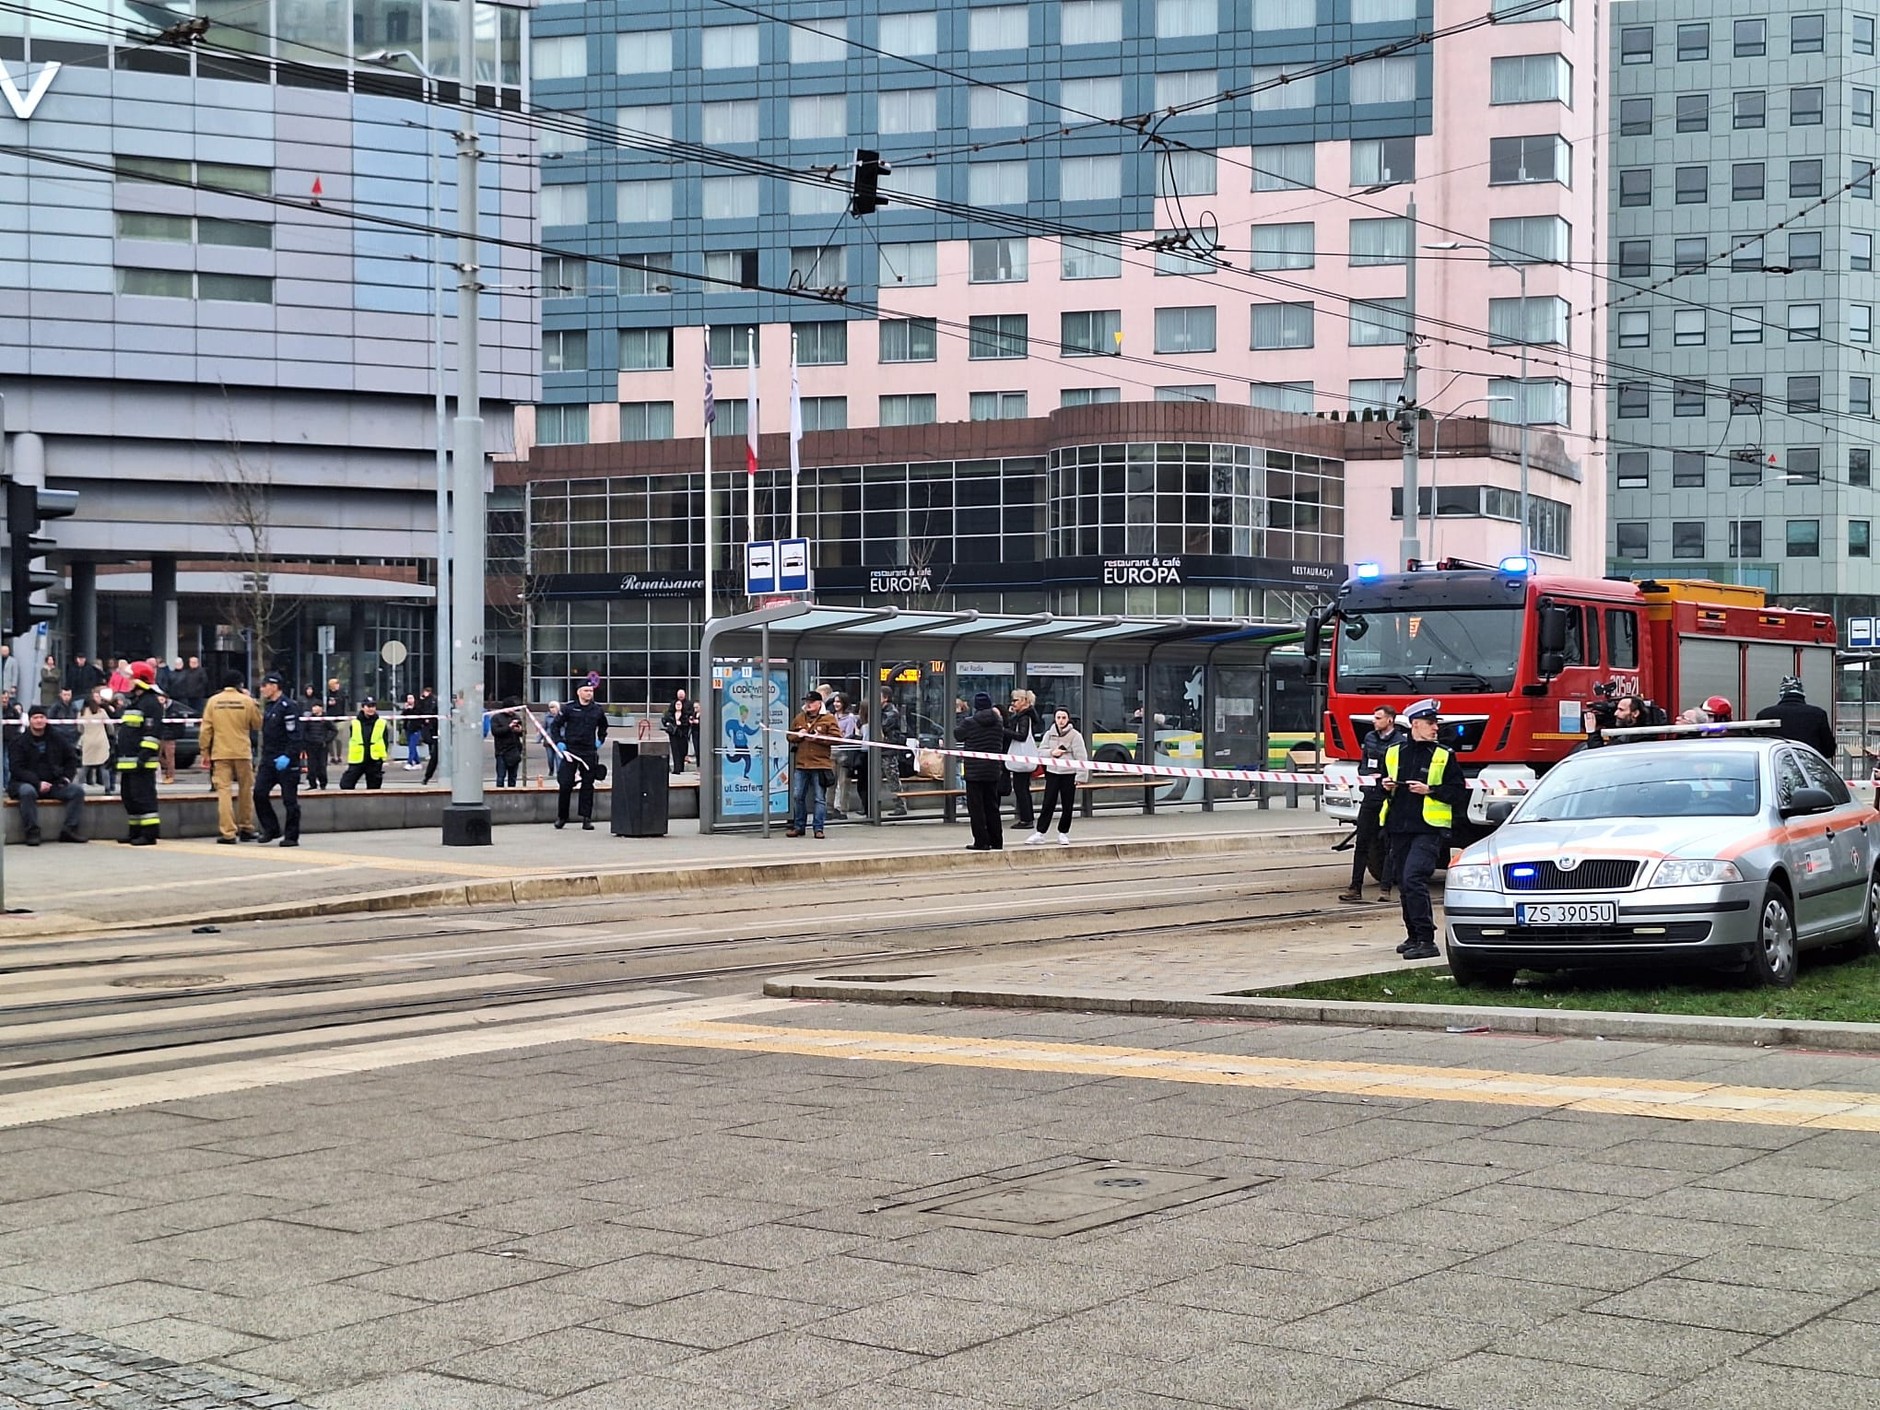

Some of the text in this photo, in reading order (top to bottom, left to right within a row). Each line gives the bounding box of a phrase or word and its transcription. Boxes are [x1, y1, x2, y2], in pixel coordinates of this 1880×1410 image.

[1103, 556, 1181, 567] restaurant & café
[870, 568, 907, 577] restaurant
[908, 567, 915, 577] &
[1103, 567, 1181, 584] EUROPA
[1292, 565, 1334, 579] RESTAURACJA
[620, 574, 704, 590] Renaissance
[1528, 906, 1551, 922] ZS
[1558, 905, 1611, 922] 3905U
